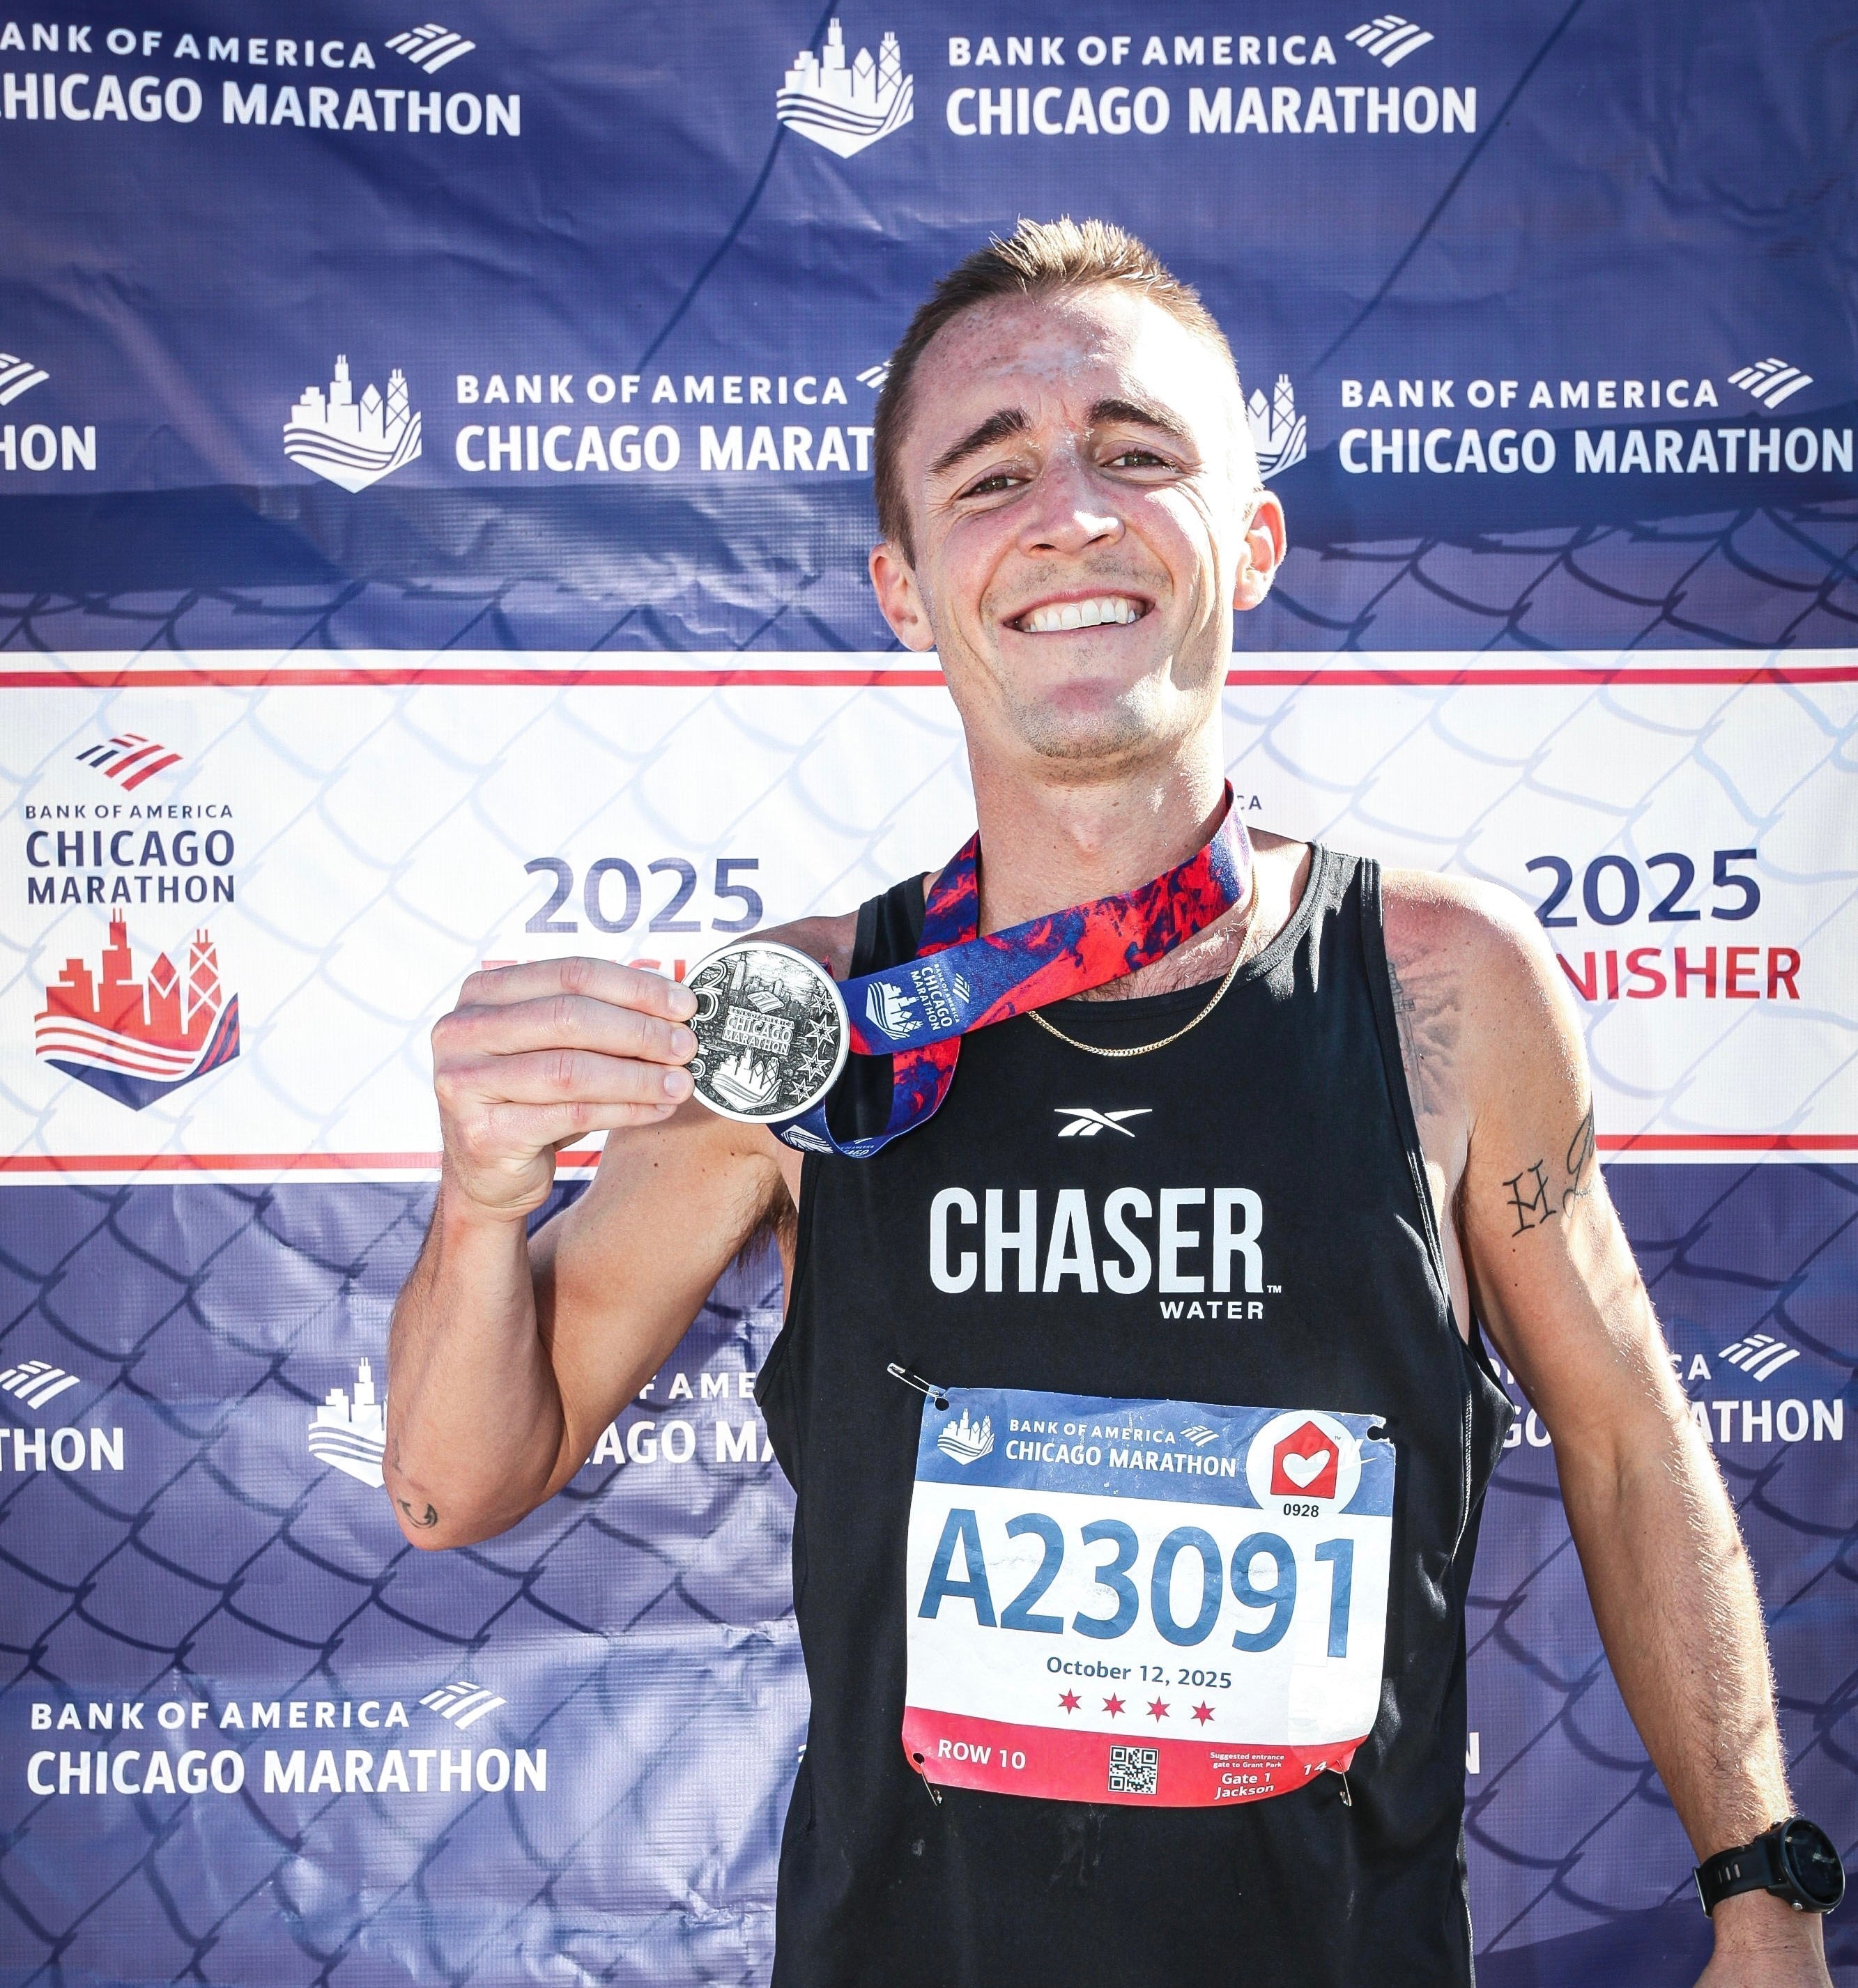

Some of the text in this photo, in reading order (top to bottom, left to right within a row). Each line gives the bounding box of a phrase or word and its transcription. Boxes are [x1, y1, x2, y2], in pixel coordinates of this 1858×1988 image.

[0, 22, 375, 69] ANK OF AMERICA
[949, 36, 1336, 66] BANK OF AMERICA
[3, 73, 520, 136] HICAGO MARATHON
[946, 86, 1476, 135] CHICAGO MARATHON
[457, 375, 847, 404] BANK OF AMERICA
[1342, 380, 1718, 408] BANK OF AMERICA
[456, 425, 875, 471] CHICAGO MARAT
[1339, 428, 1852, 473] CHICAGO MARATHON
[26, 805, 232, 819] BANK OF AMERICA
[26, 830, 233, 867] CHICAGO
[28, 875, 234, 904] MARATHON
[524, 857, 763, 933] 2025
[1526, 849, 1760, 928] 2025
[1556, 947, 1800, 1001] NISHER
[910, 970, 941, 1031] MARATHON
[921, 966, 953, 1027] CHICAGO
[722, 1028, 790, 1056] MARATHON
[725, 1014, 793, 1043] CHICAGO
[930, 1187, 1264, 1294] CHASER
[1160, 1302, 1263, 1319] WATER
[1008, 1419, 1177, 1445] BANK OF AMERICA
[1685, 1398, 1843, 1443] ATHON
[1005, 1438, 1237, 1478] CHICAGO MARATHON
[1284, 1504, 1319, 1517] 0928
[917, 1509, 1353, 1658] A23091
[1047, 1657, 1231, 1688] October 12, 2025
[31, 1701, 409, 1729] BANK OF AMERICA
[938, 1739, 1025, 1769] ROW 10
[1209, 1751, 1250, 1761] Suggested
[28, 1750, 546, 1794] CHICAGO MARATHON
[1222, 1772, 1270, 1785] Gate 1
[1214, 1785, 1274, 1799] Jackson
